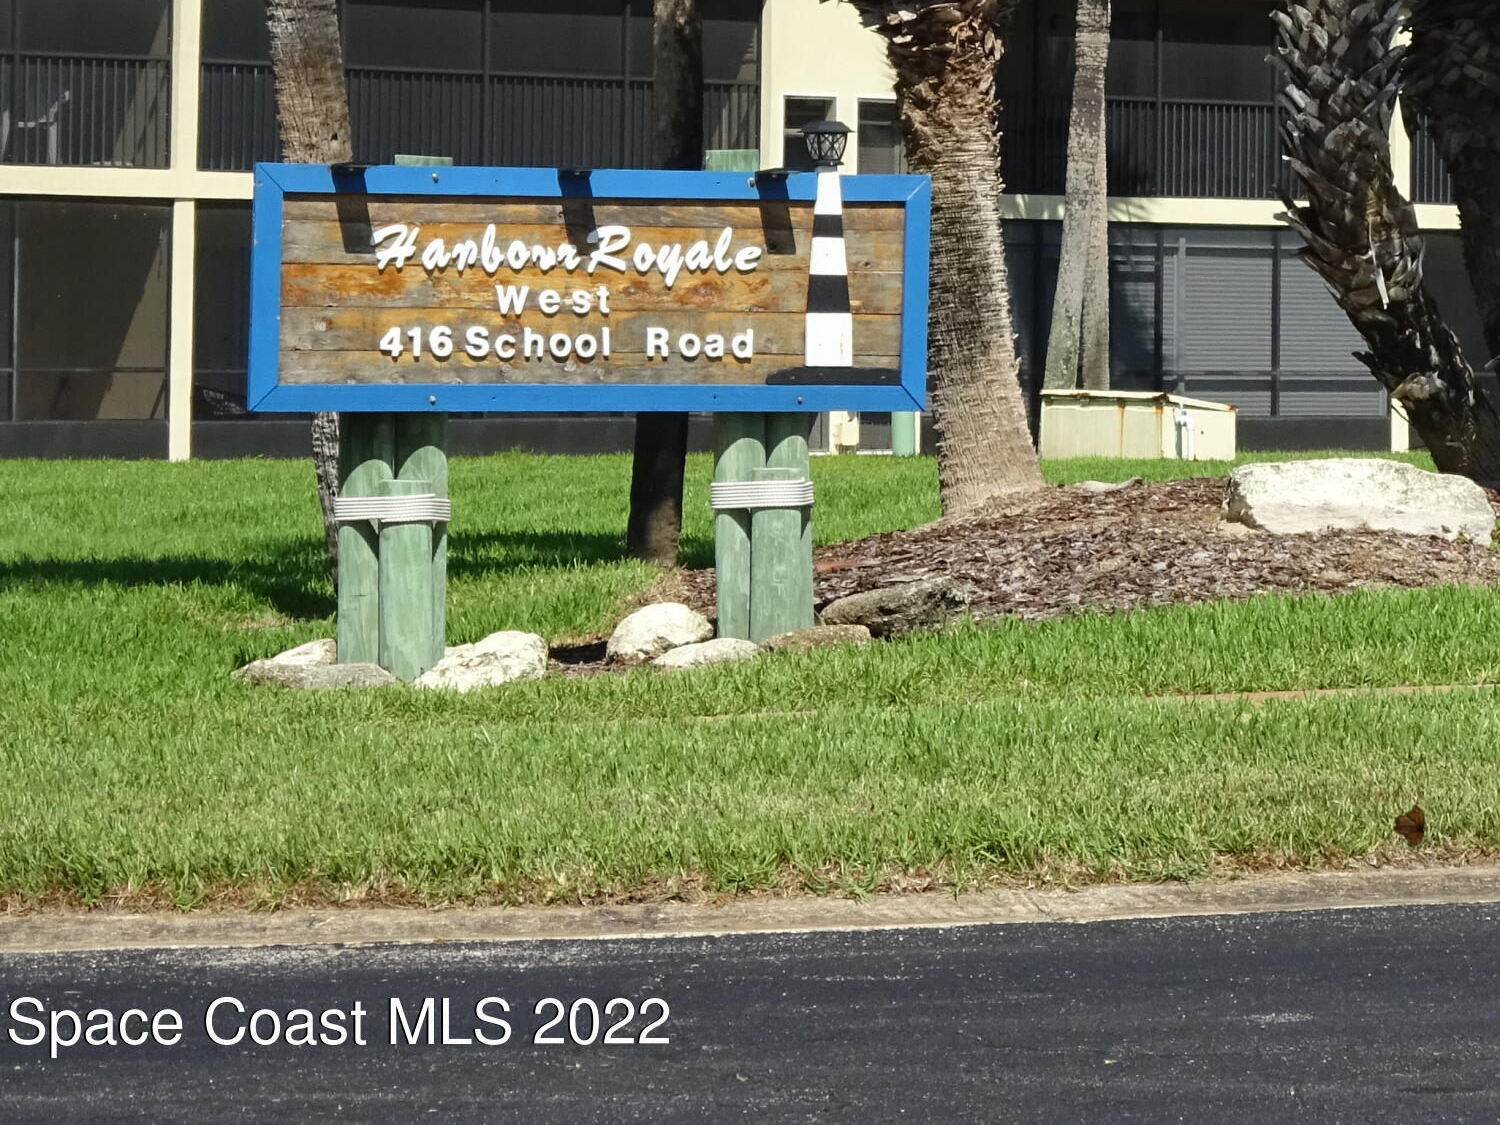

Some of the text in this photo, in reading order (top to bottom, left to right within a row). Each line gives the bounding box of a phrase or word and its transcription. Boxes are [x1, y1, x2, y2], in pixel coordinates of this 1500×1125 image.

[371, 223, 763, 288] Harbour Royale
[495, 284, 611, 315] West
[379, 325, 755, 359] 416 School Road
